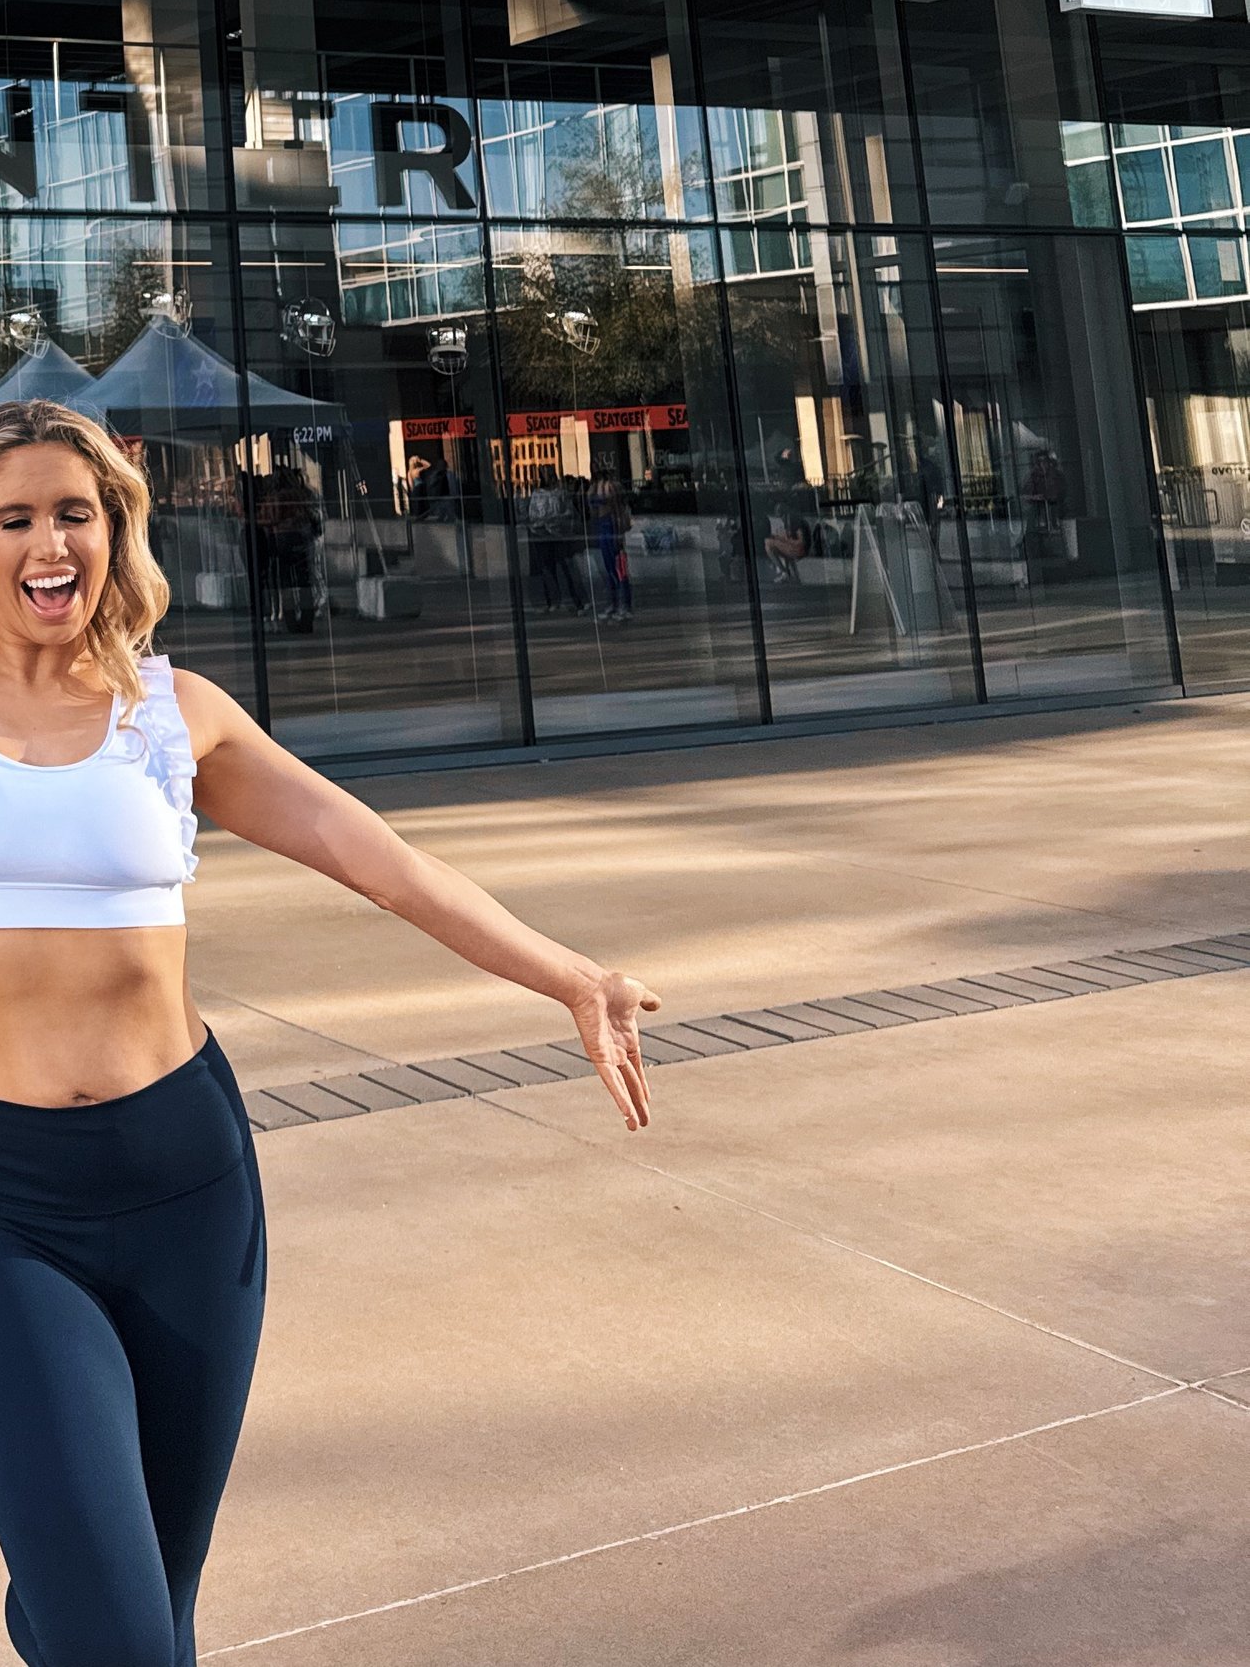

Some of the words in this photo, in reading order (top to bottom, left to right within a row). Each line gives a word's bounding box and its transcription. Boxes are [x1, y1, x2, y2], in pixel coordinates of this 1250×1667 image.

[293, 426, 314, 444] 6:22
[316, 425, 333, 442] PM
[405, 421, 450, 438] SEATGEEK
